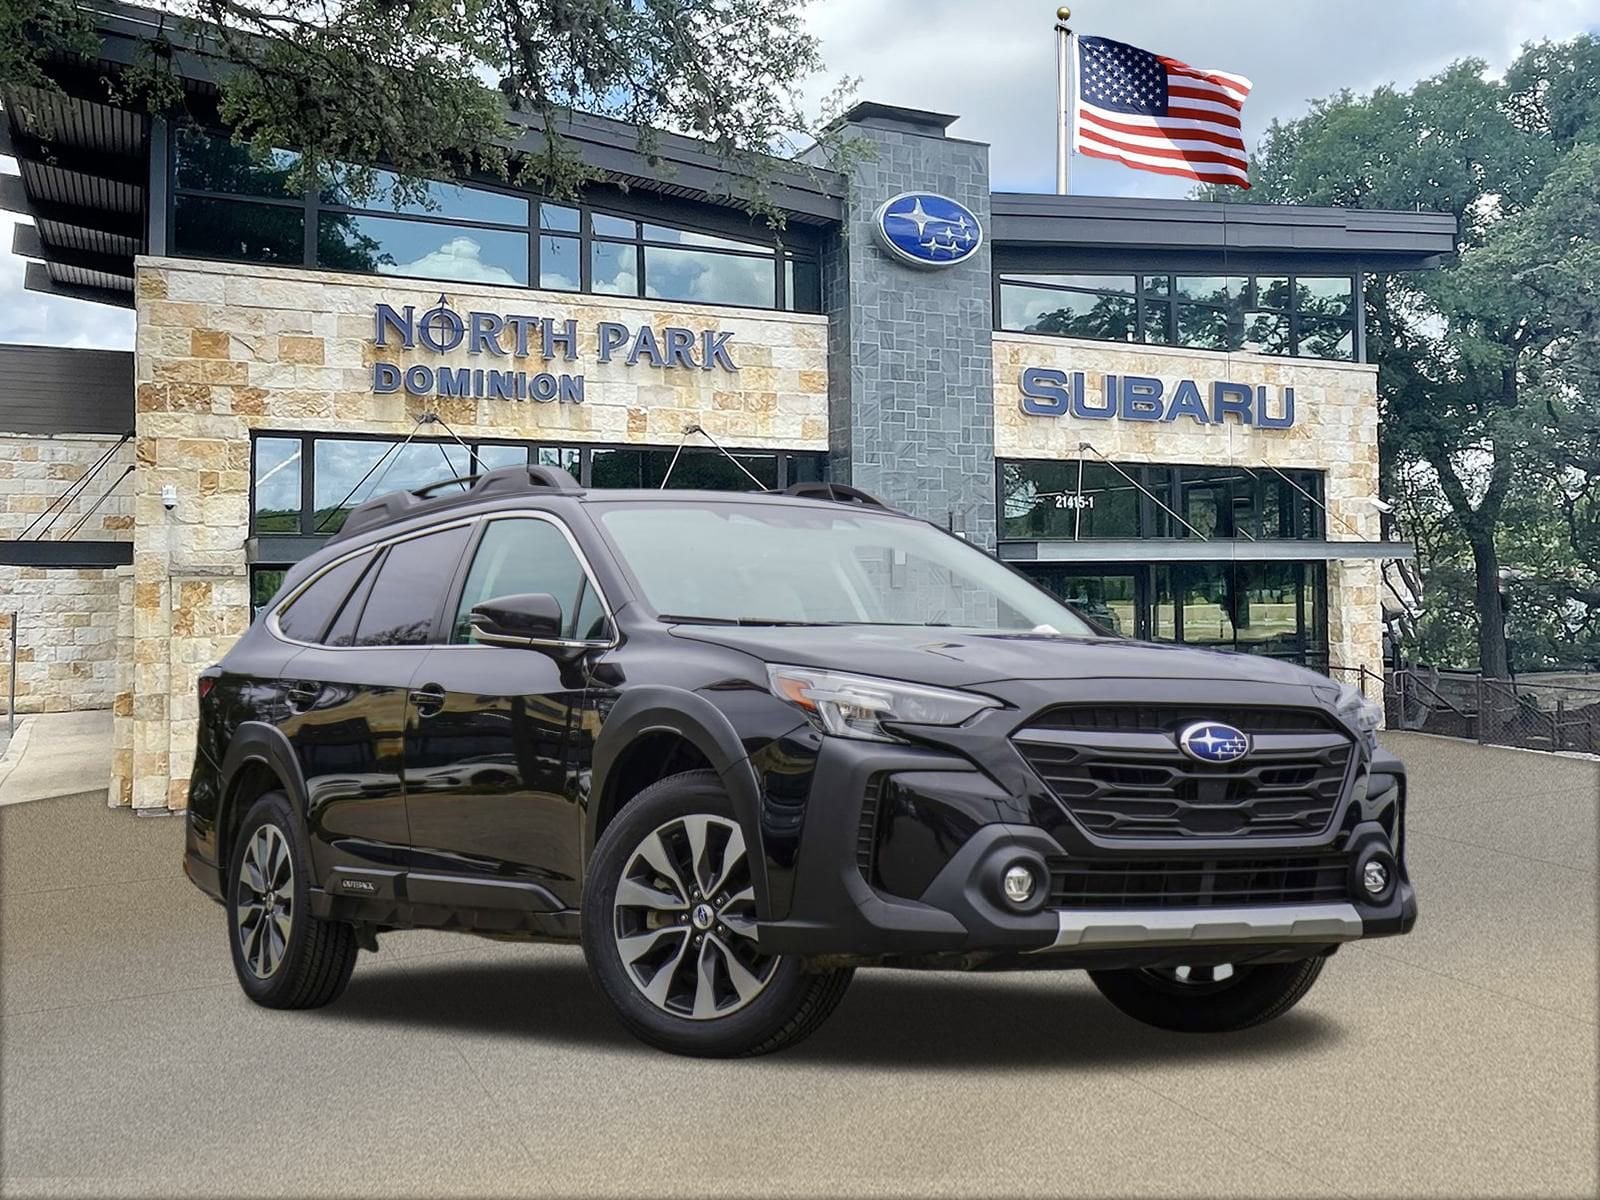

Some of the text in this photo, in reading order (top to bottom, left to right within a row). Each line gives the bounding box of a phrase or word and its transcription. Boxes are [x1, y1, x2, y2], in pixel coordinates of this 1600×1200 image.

[374, 293, 740, 372] NORTH PARK
[373, 361, 585, 404] DOMINION
[1019, 367, 1295, 430] SUBARU
